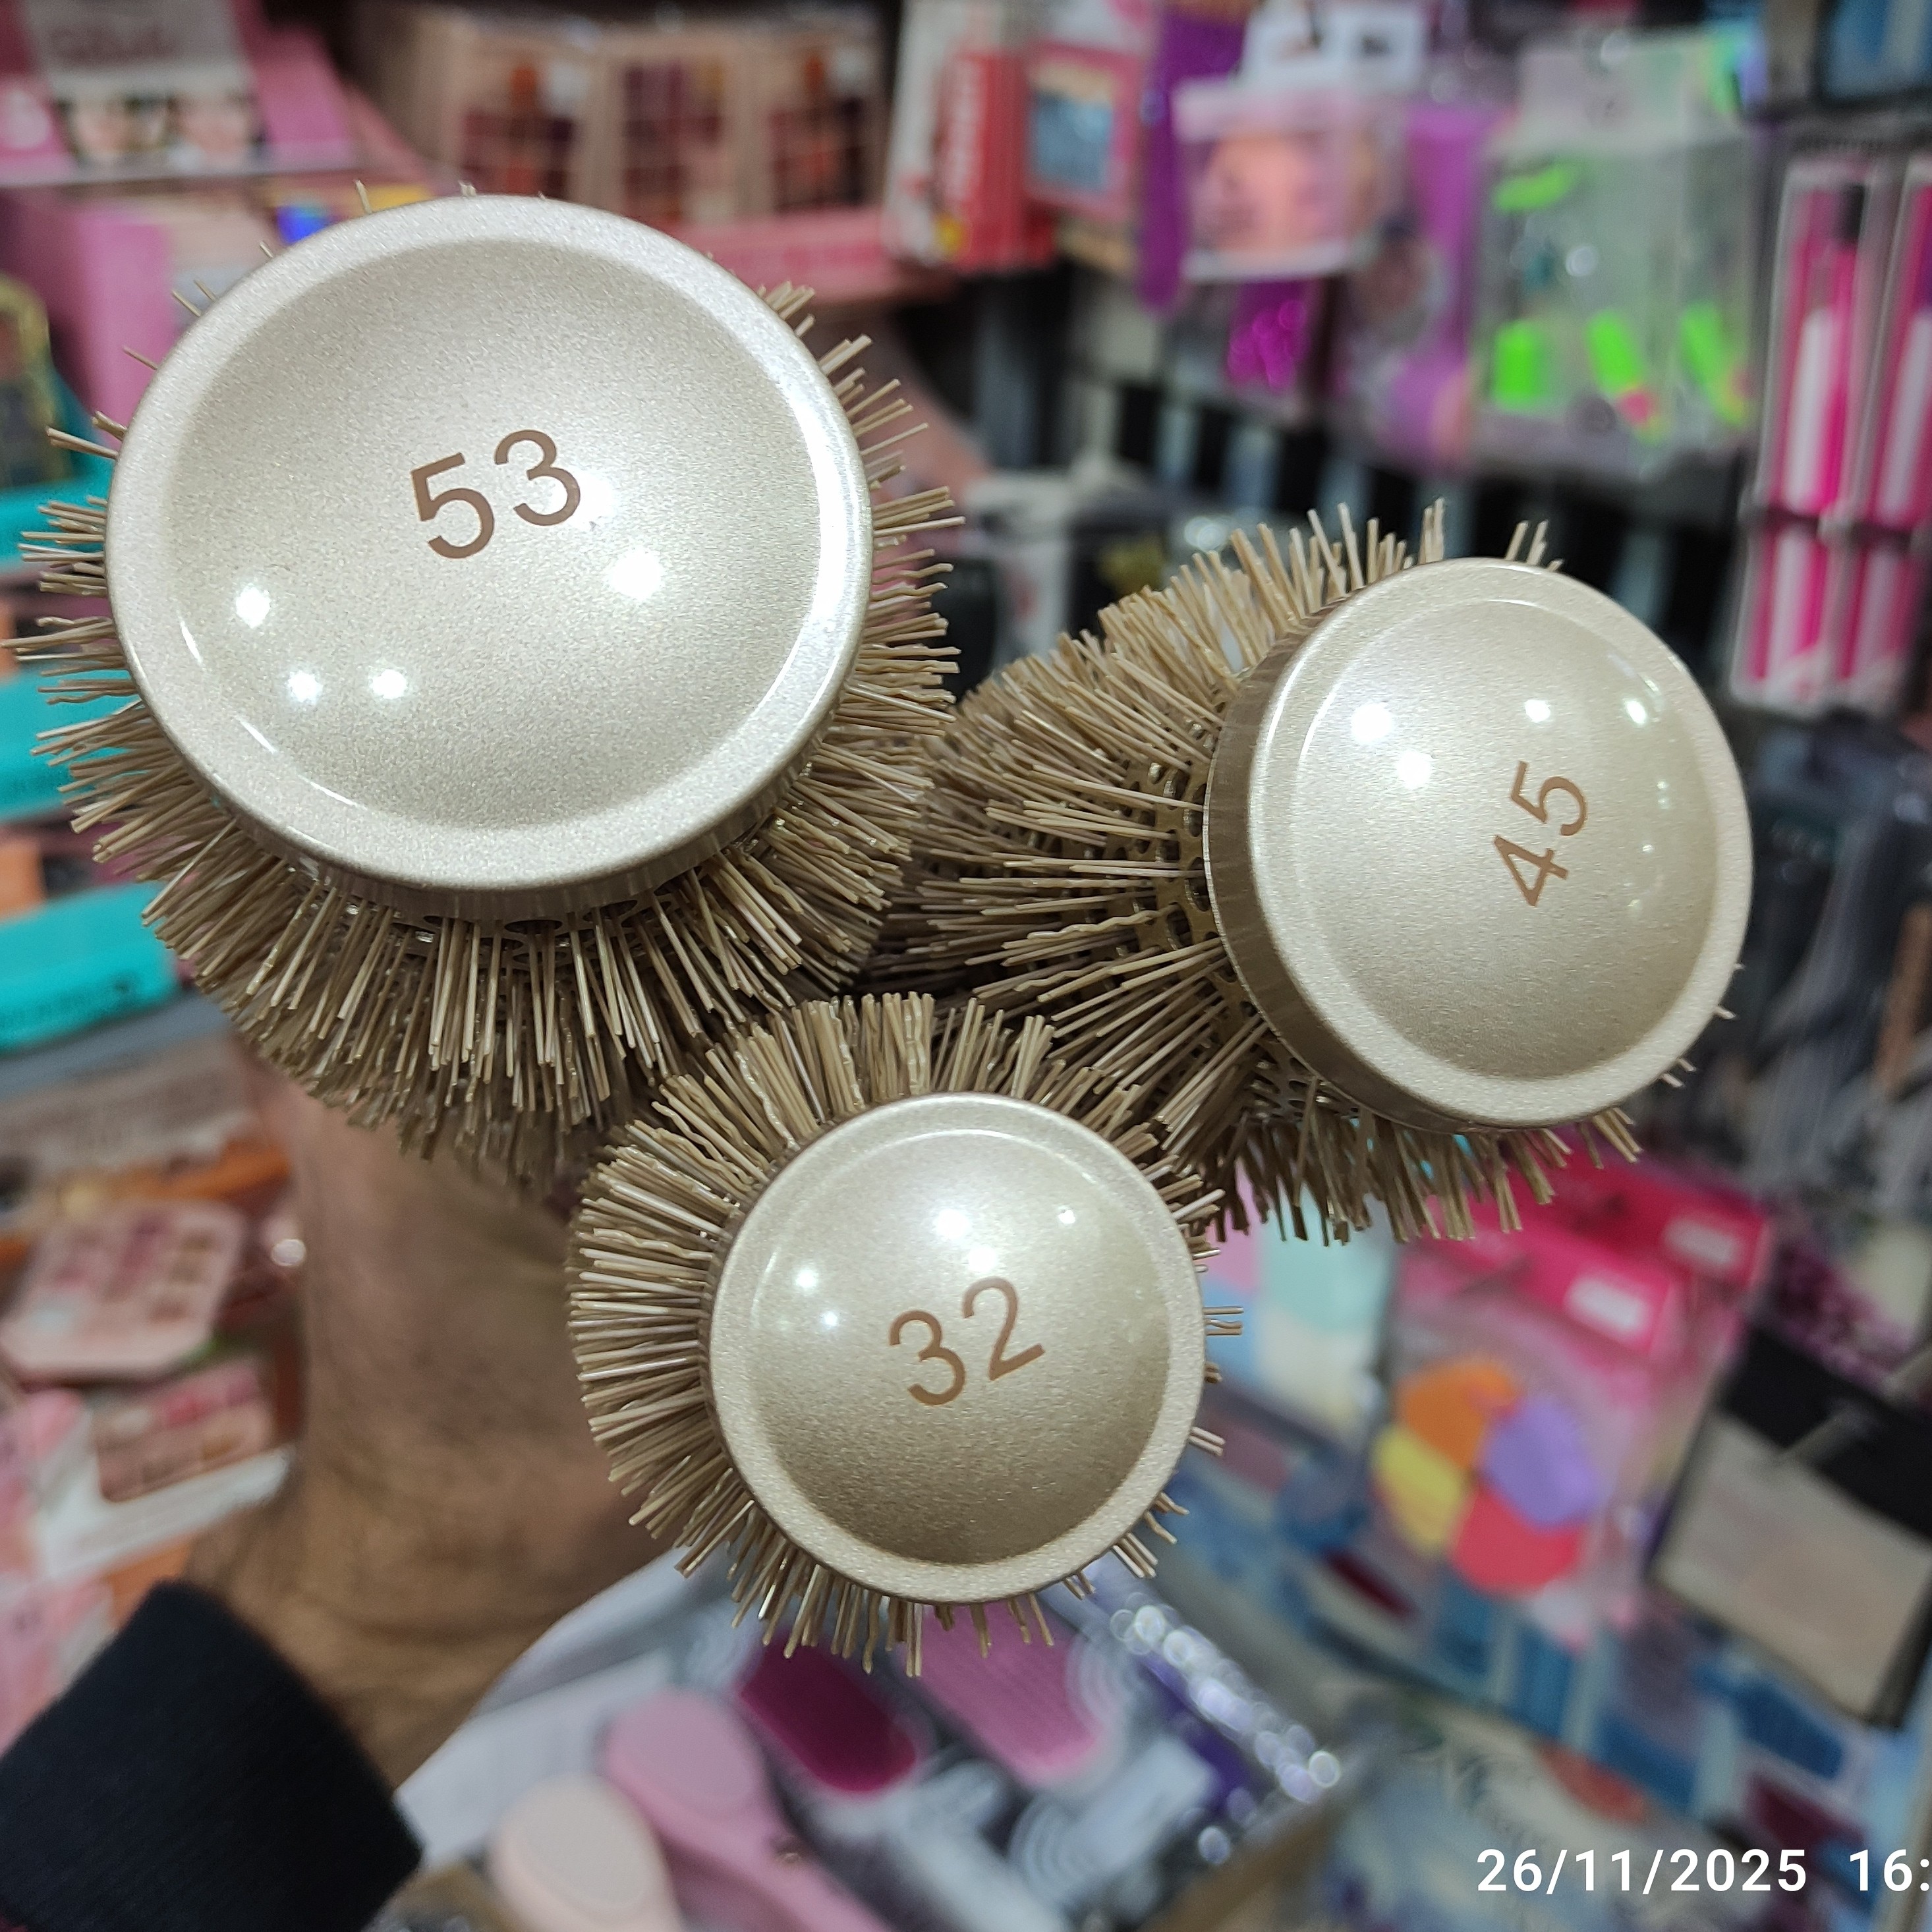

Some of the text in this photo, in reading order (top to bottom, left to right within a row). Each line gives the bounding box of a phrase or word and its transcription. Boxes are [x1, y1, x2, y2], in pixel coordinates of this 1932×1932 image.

[411, 430, 581, 559] 53
[1493, 760, 1587, 906] 45
[889, 1276, 1045, 1406] 32
